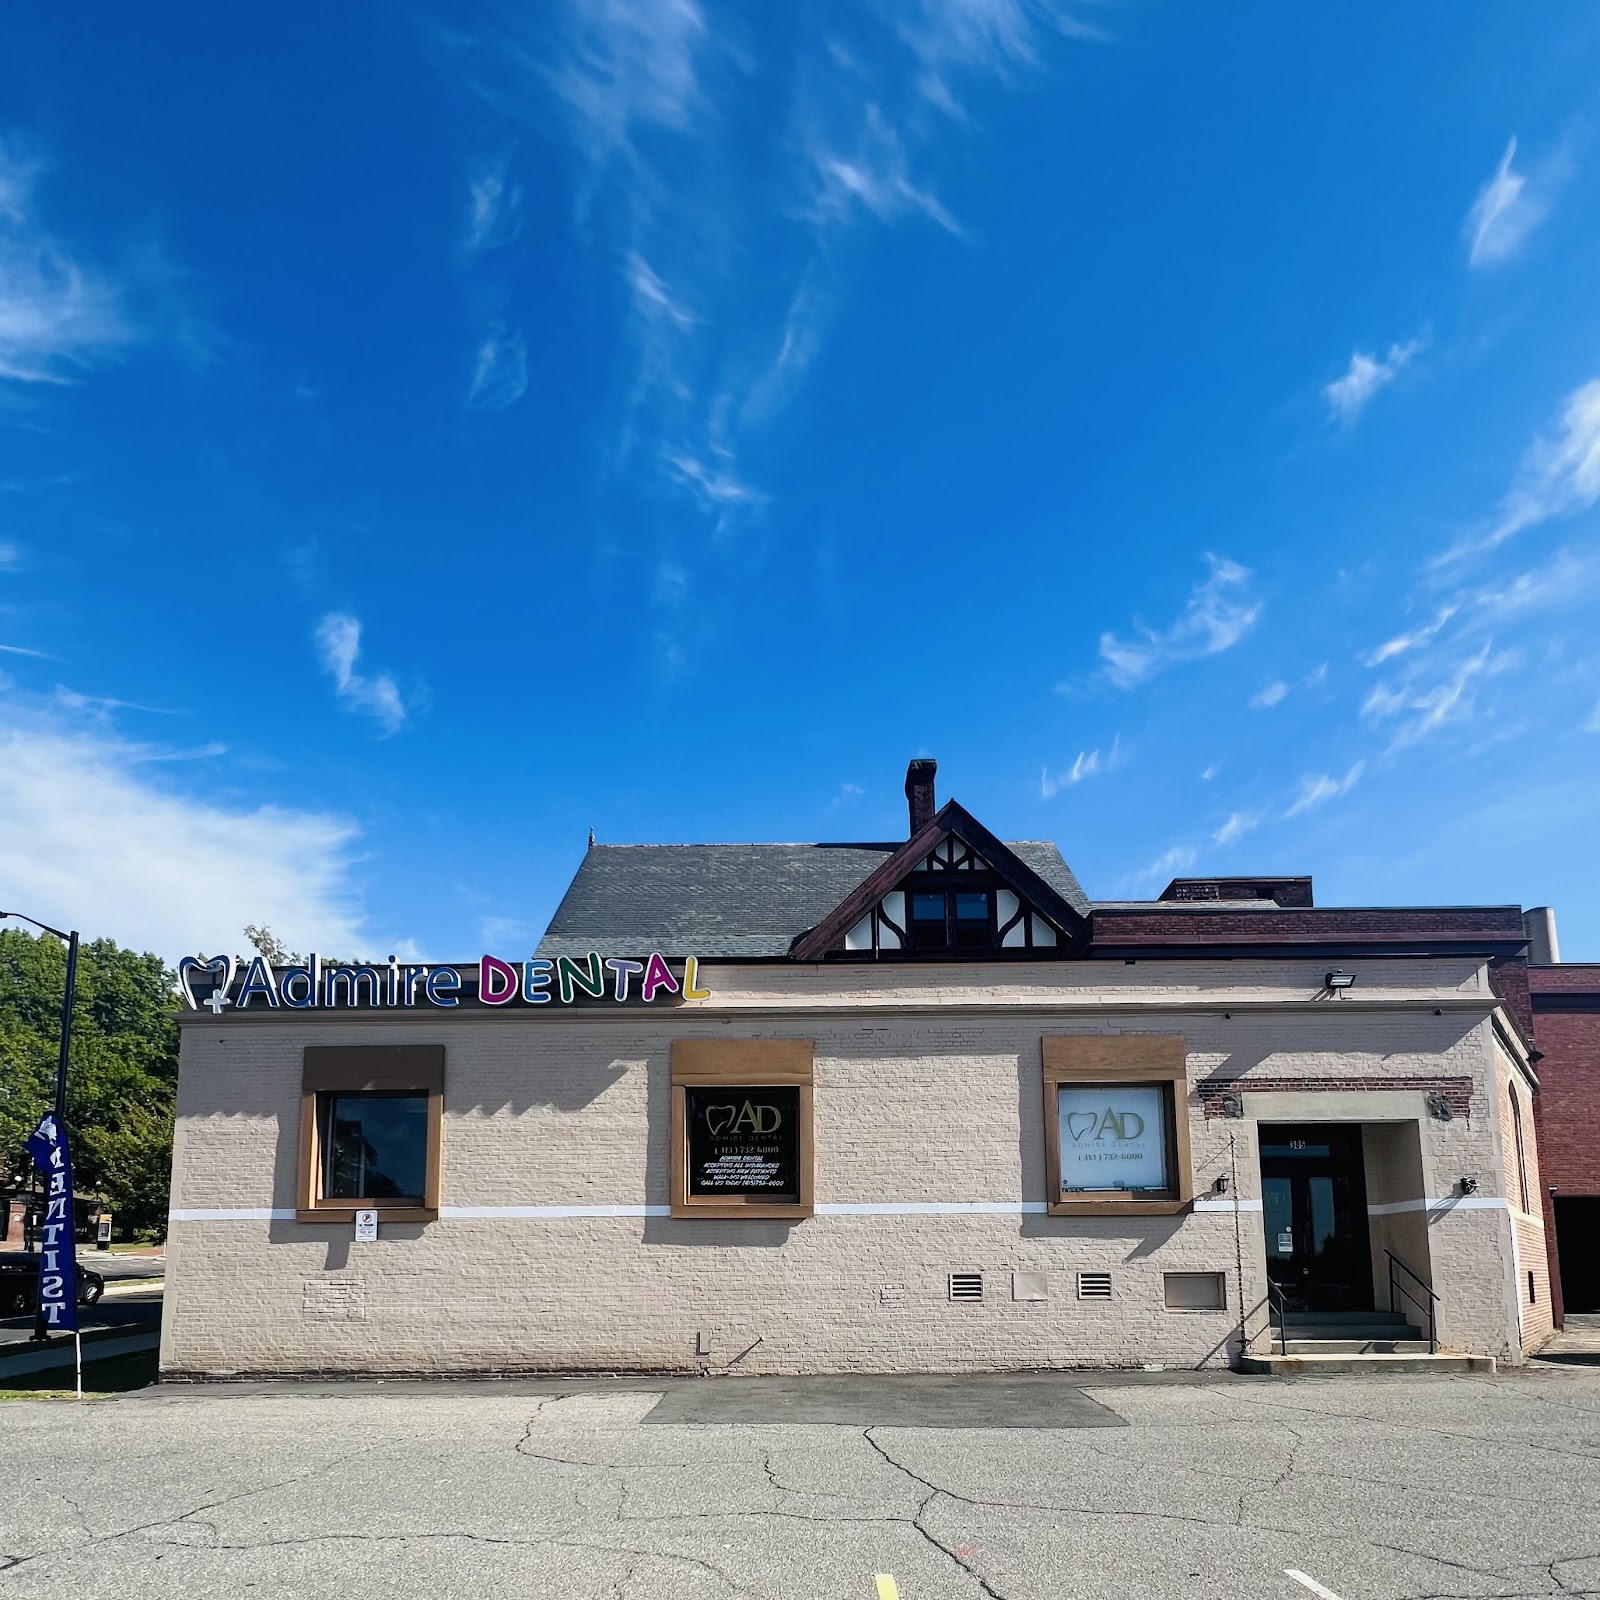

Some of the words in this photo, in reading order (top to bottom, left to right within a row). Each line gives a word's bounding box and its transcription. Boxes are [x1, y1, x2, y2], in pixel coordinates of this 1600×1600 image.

[236, 953, 462, 1008] Admire
[478, 950, 712, 1006] DENTAL
[730, 1099, 782, 1133] AD
[1093, 1106, 1144, 1140] AD
[1290, 1140, 1305, 1149] 305
